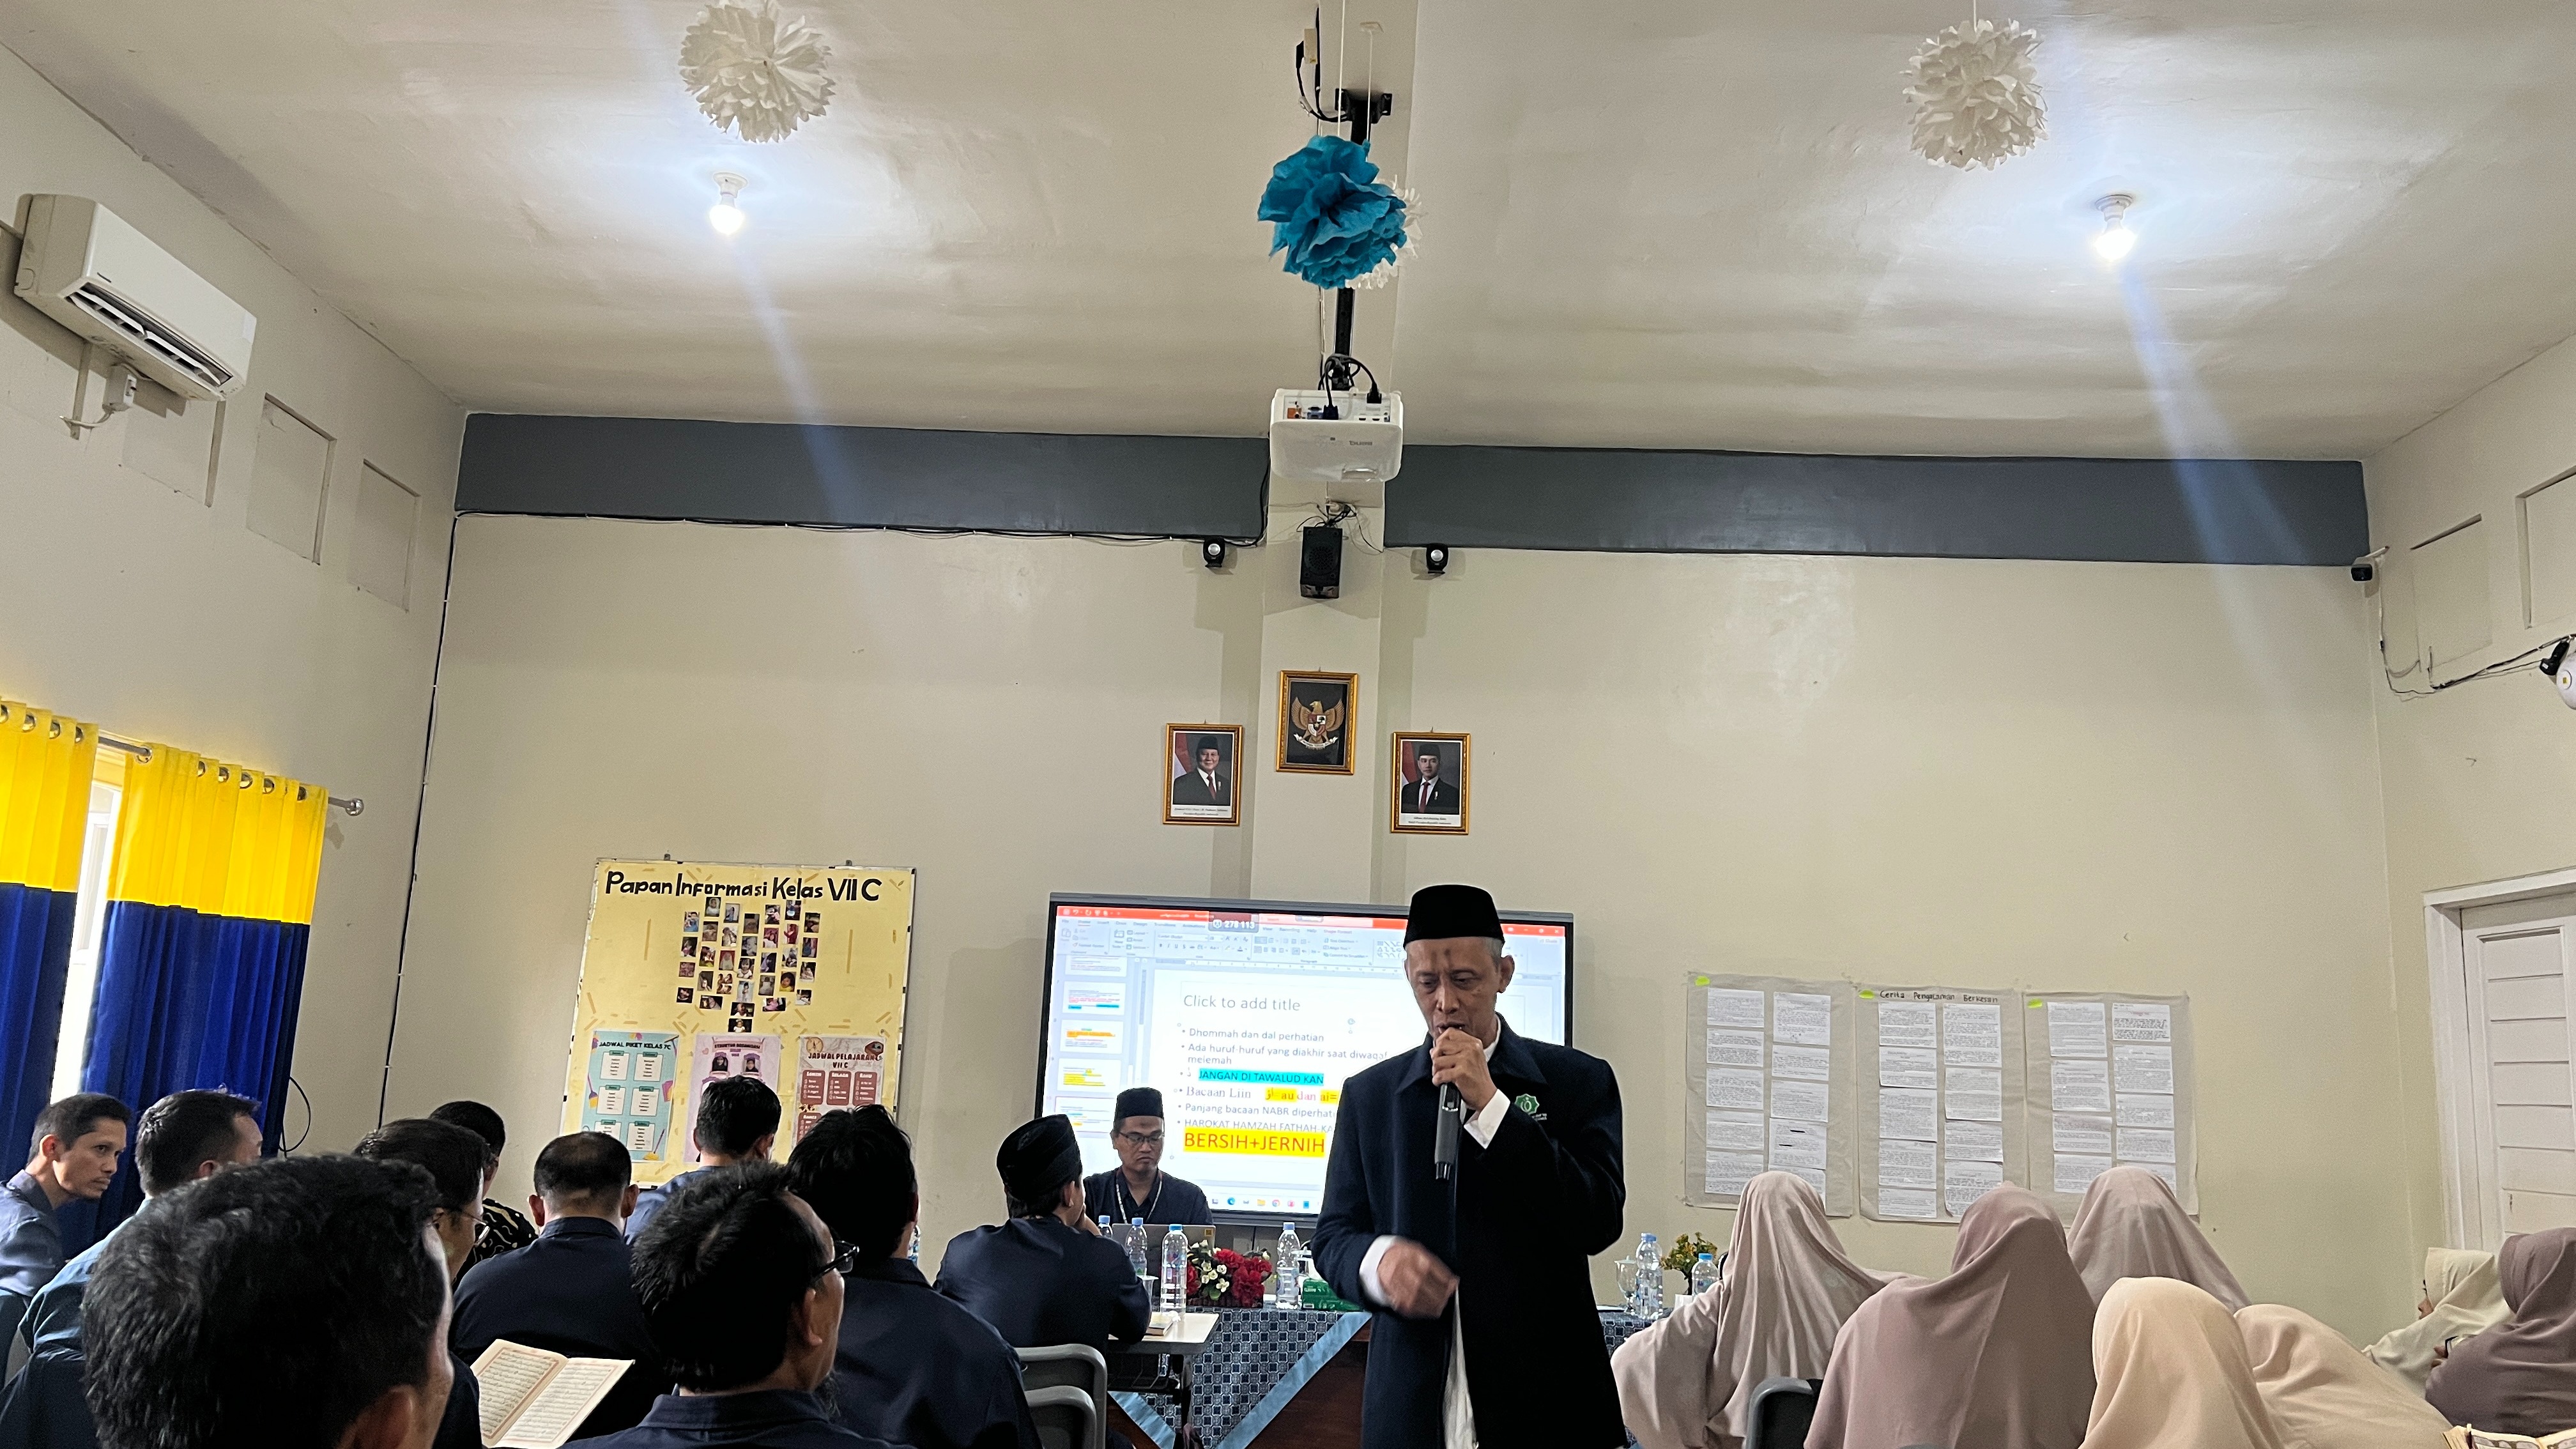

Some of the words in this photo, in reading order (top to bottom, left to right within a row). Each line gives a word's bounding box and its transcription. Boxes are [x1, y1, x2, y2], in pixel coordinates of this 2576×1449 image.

[605, 871, 673, 895] Papan
[675, 873, 767, 897] Informasi
[772, 877, 823, 900] Kelas
[827, 877, 857, 901] VII
[861, 878, 882, 901] C
[1183, 995, 1216, 1008] Click
[1222, 997, 1236, 1008] to
[1240, 997, 1268, 1009] add
[1272, 998, 1301, 1011] title
[1880, 990, 1905, 999] Cerita
[1913, 992, 1955, 1002] Pengalaman
[1963, 994, 1998, 1003] Berkesan
[1189, 1028, 1238, 1038] Dhommah
[1241, 1030, 1259, 1039] dan
[1262, 1031, 1276, 1039] dal
[1278, 1032, 1324, 1042] perhatian
[1188, 1043, 1207, 1052] Ada
[1209, 1045, 1265, 1055] huruf-huruf
[1268, 1048, 1289, 1057] yang
[1292, 1047, 1324, 1057] diakhir
[1328, 1050, 1347, 1059] saat
[1188, 1055, 1232, 1064] melemah
[1199, 1070, 1239, 1080] JANGAN
[1241, 1071, 1252, 1081] DI
[1254, 1073, 1300, 1083] TAWALUD
[1304, 1075, 1324, 1084] KAN
[1186, 1086, 1225, 1098] Bacaan
[1229, 1087, 1251, 1099] Liin
[1297, 1091, 1316, 1101] dan
[1185, 1103, 1223, 1114] Panjang
[1226, 1105, 1259, 1114] bacaan
[1262, 1107, 1289, 1116] NABR
[1184, 1119, 1230, 1128] HAROKAT
[1233, 1121, 1276, 1131] HAMZAH
[1184, 1132, 1324, 1153] BERSIH+JERNIH
